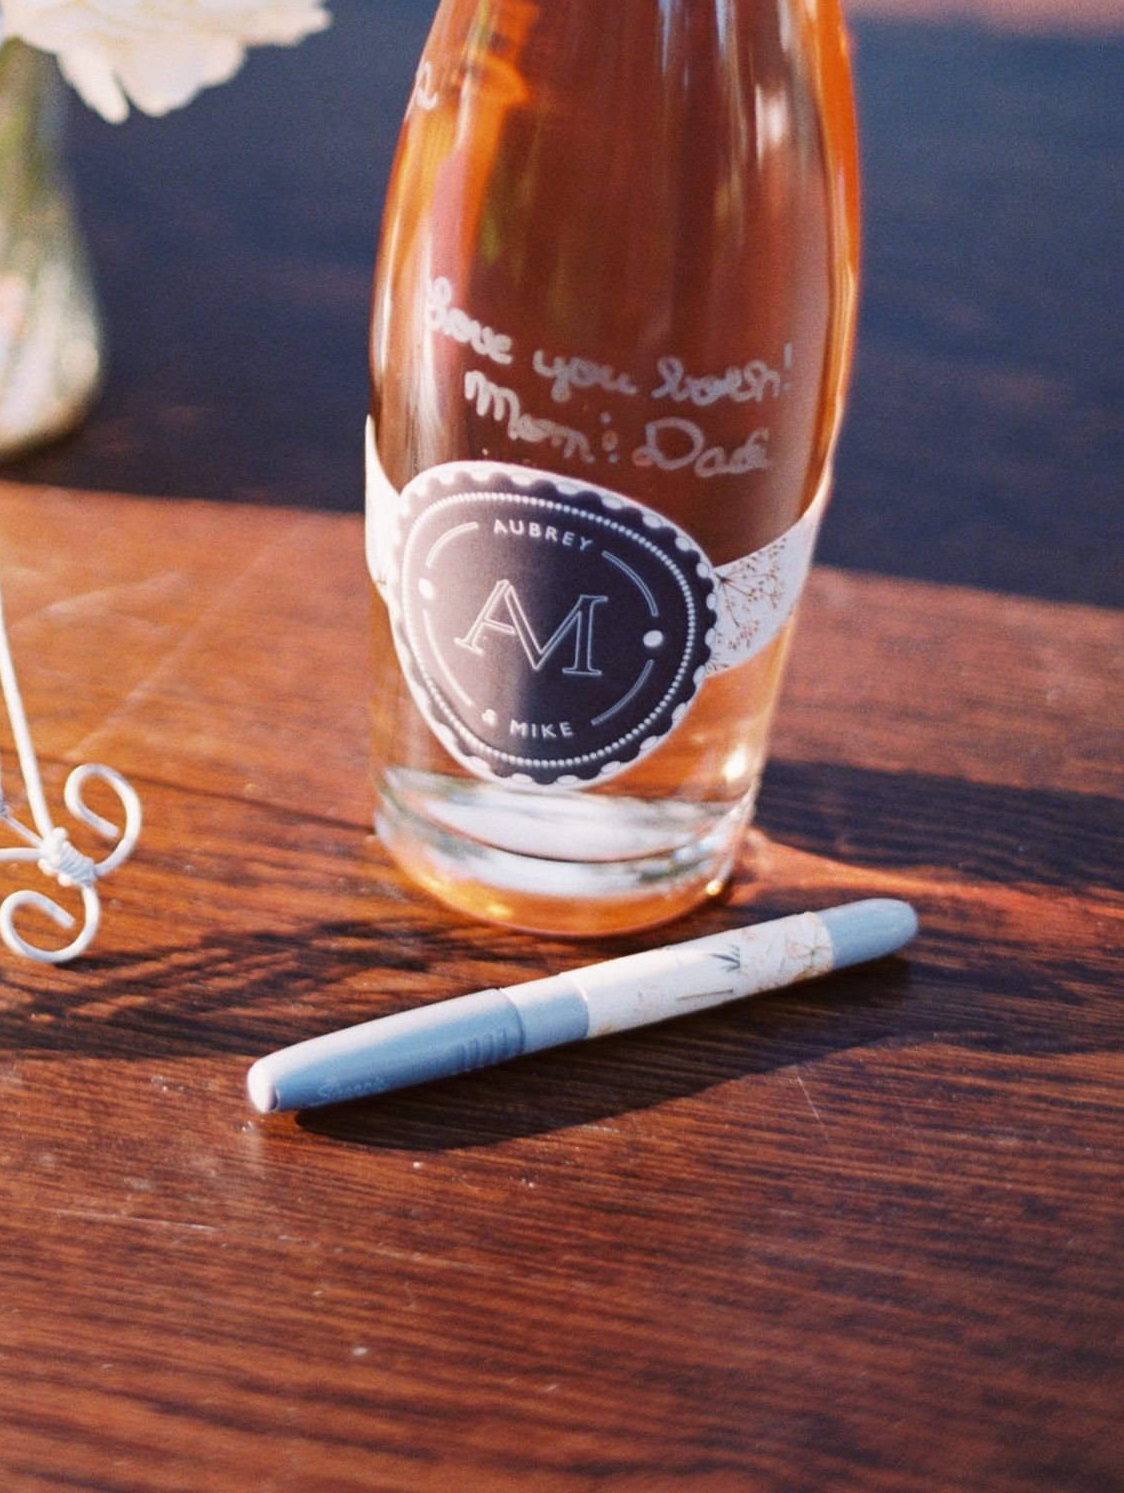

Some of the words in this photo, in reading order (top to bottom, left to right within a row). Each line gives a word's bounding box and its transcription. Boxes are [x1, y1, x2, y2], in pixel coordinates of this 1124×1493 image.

[532, 349, 638, 402] you
[464, 370, 596, 462] Mom
[632, 415, 772, 478] Dad
[493, 519, 593, 551] AUBREY
[481, 709, 498, 726] &
[509, 718, 575, 740] MIKE
